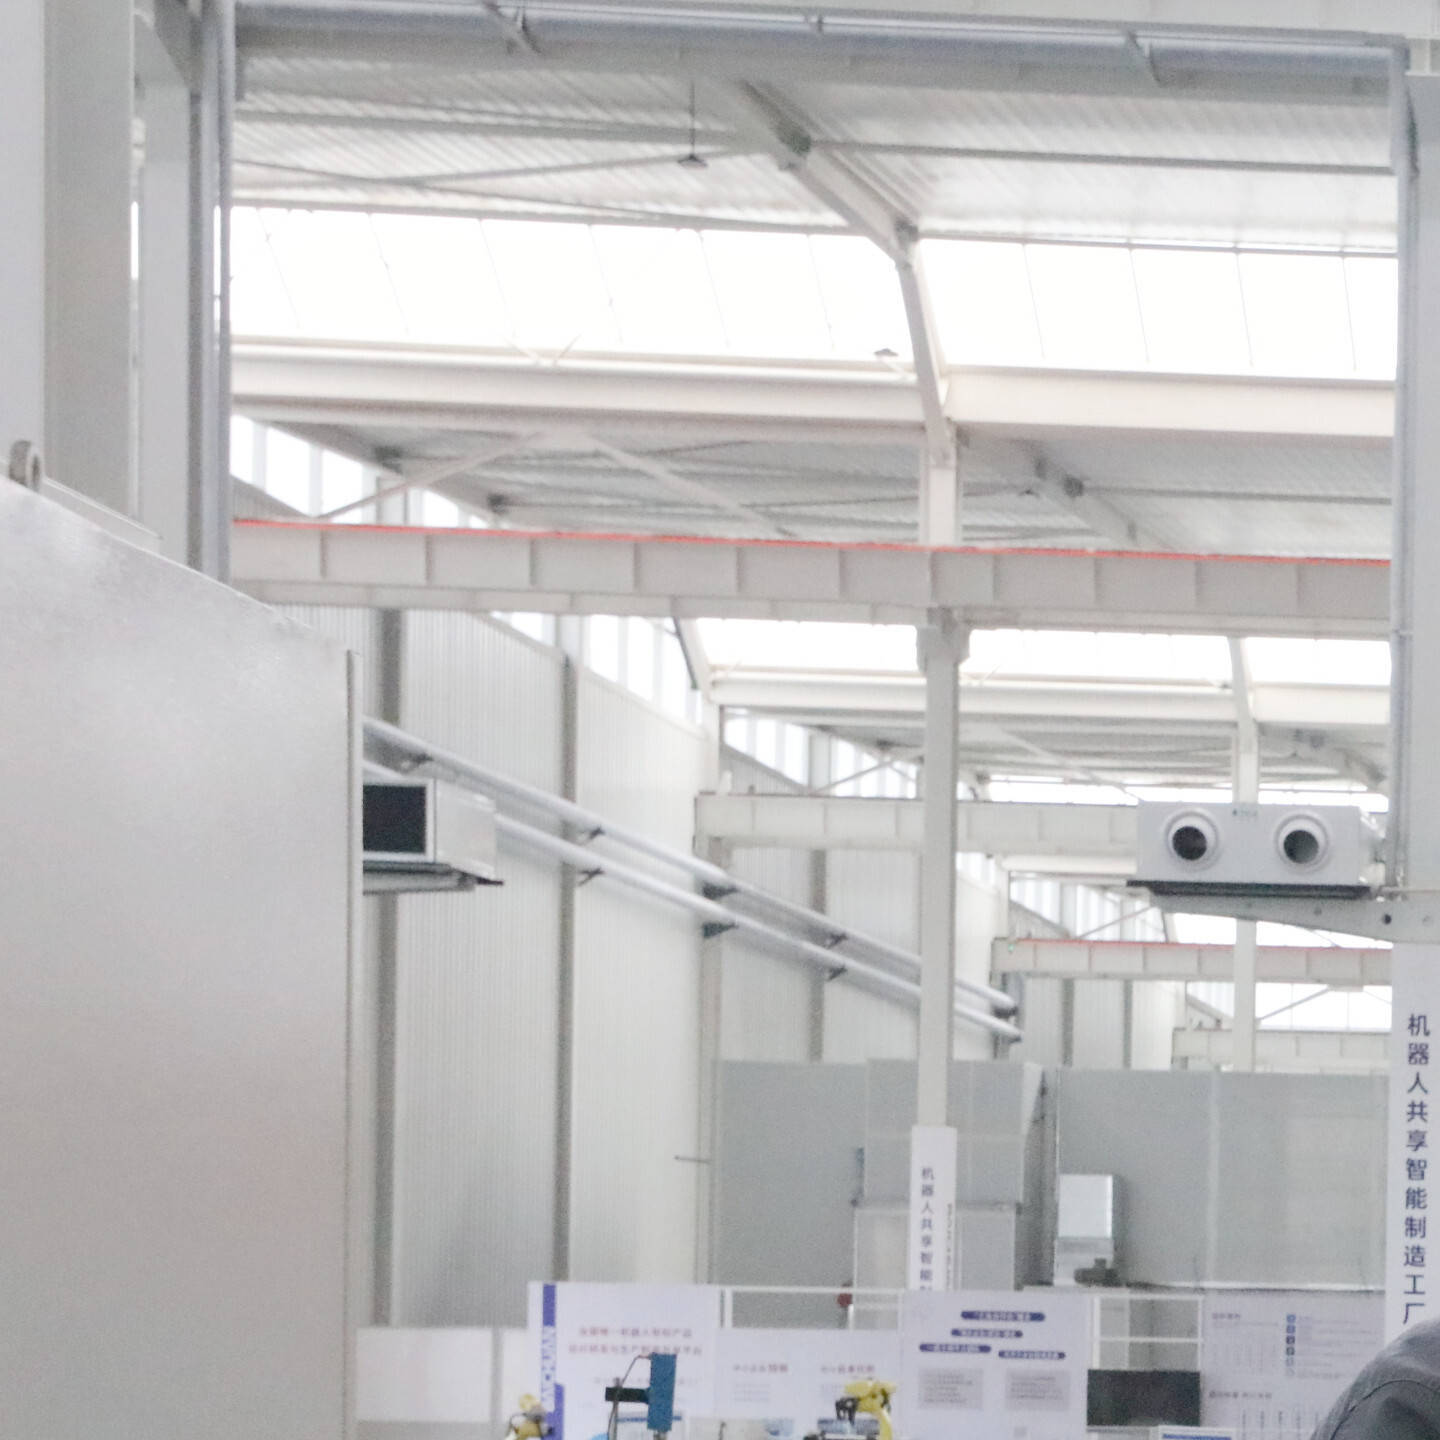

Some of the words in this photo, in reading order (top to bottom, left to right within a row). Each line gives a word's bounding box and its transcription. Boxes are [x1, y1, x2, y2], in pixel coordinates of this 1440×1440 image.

[919, 1166, 935, 1292] 机器人共享智能
[1402, 1013, 1431, 1325] 机器人共享智能制造工厂
